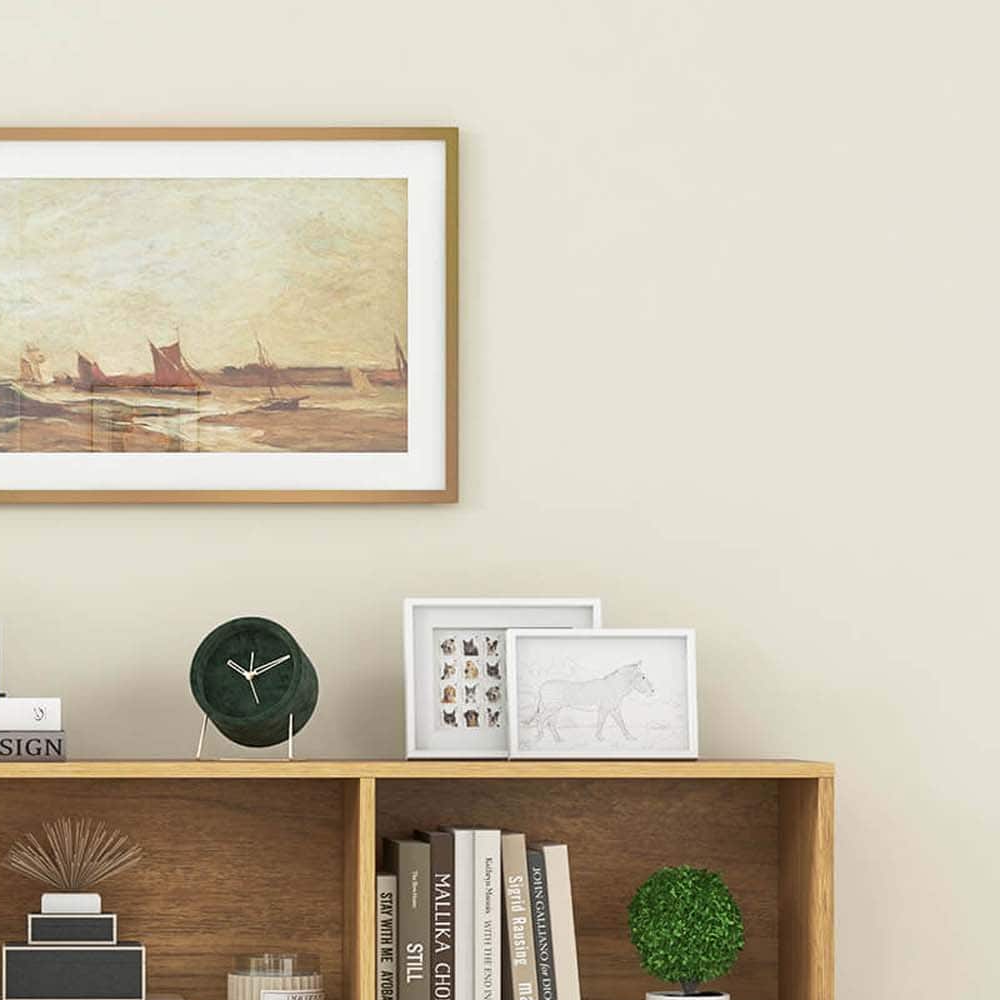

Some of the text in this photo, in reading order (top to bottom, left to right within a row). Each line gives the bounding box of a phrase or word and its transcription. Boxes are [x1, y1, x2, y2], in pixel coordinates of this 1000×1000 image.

[507, 875, 525, 912] Sigrid
[532, 866, 544, 899] JOHN
[381, 892, 393, 916] STAY
[434, 873, 451, 953] MALLIKA
[381, 918, 393, 944] WITH
[483, 920, 493, 945] WITH
[512, 916, 528, 966] Rausing
[535, 901, 549, 961] GALLIANO
[381, 948, 393, 963] ME
[406, 942, 424, 983] STILL
[483, 946, 493, 965] THE
[540, 963, 551, 976] for
